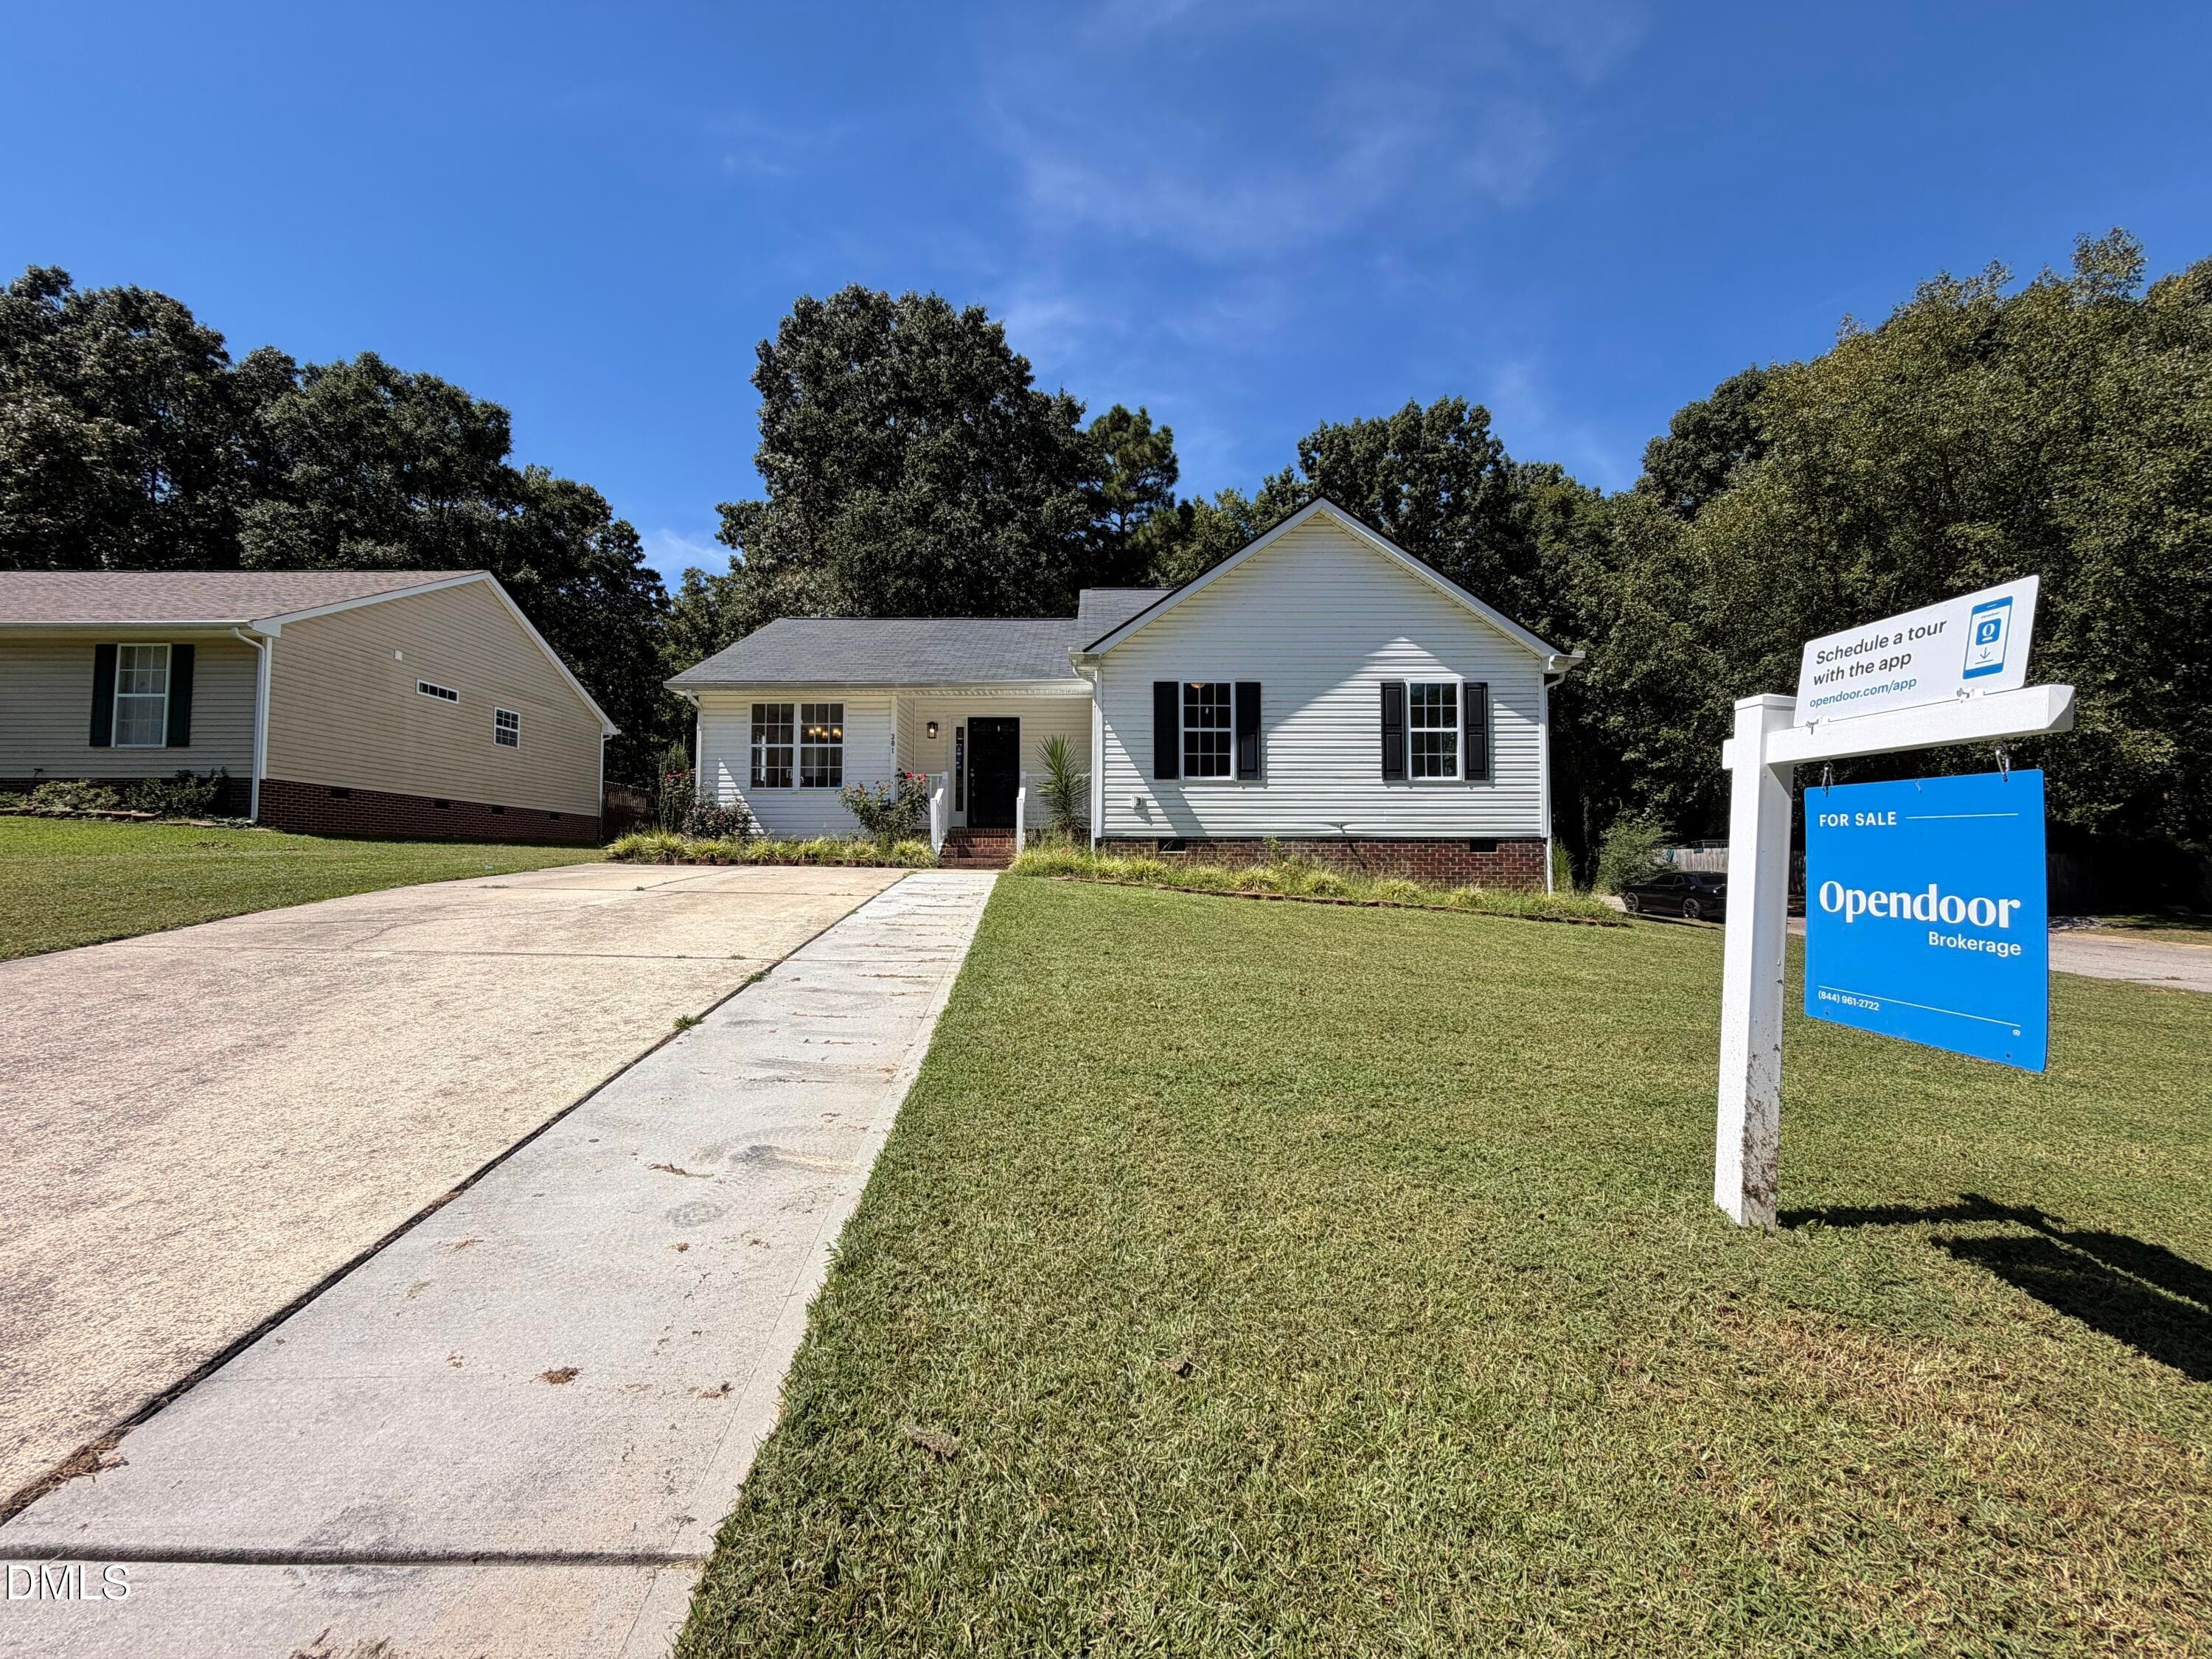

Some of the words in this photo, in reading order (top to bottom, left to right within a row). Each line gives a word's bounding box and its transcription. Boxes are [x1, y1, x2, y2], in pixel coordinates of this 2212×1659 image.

[1816, 636, 1890, 664] Schedule
[1893, 633, 1903, 646] a
[1907, 619, 1947, 641] tour
[1813, 667, 1844, 686] with
[1849, 658, 1877, 678] the
[1879, 652, 1912, 674] app
[1809, 677, 1917, 708] opendoor.com/app
[1819, 813, 1849, 827] FOR
[1855, 812, 1897, 827] SALE
[1819, 880, 2021, 928] Opendoor
[1928, 931, 2022, 957] Brokerage
[1818, 990, 1840, 1004] (844)
[1841, 995, 1880, 1011] 961-2722
